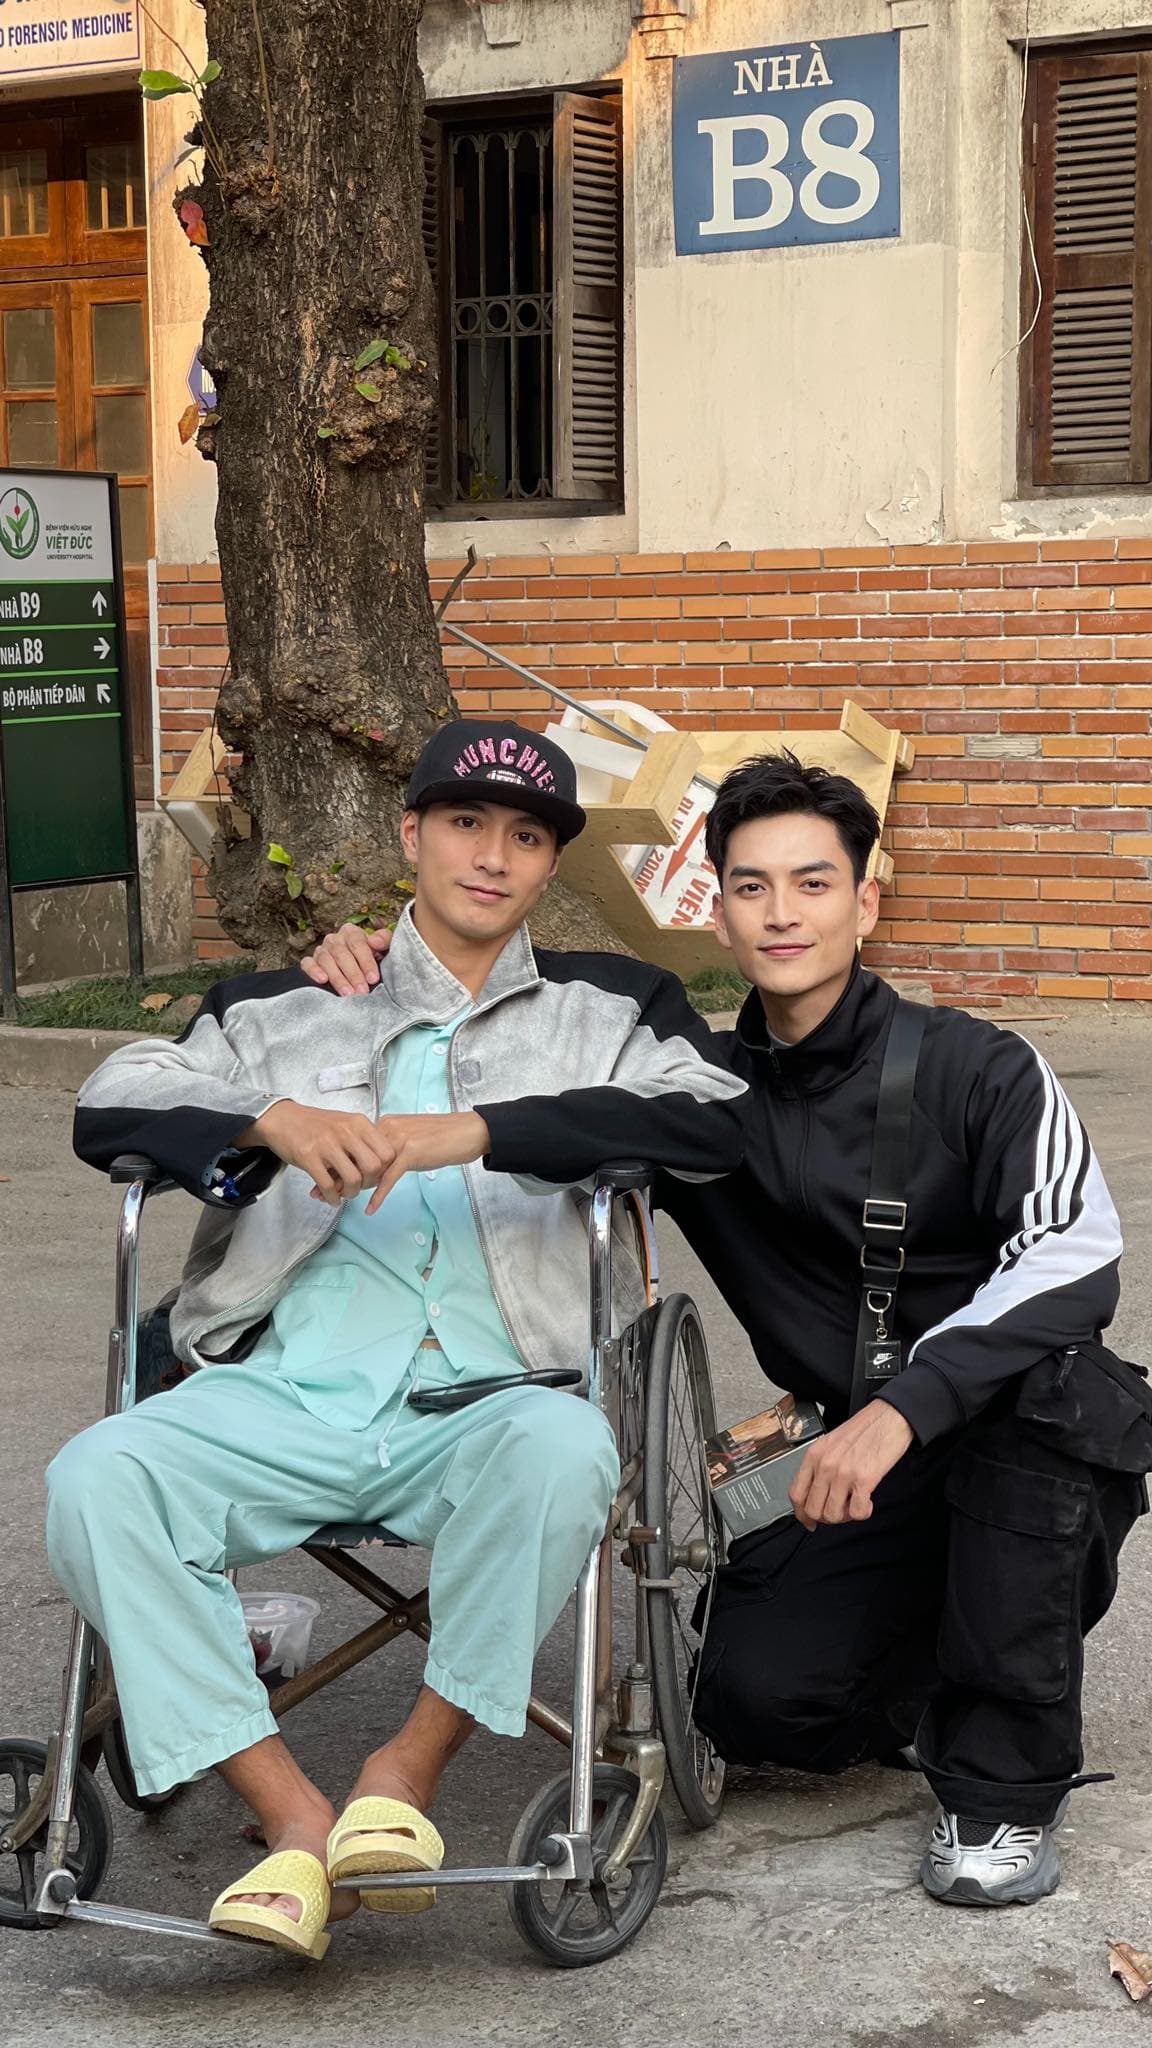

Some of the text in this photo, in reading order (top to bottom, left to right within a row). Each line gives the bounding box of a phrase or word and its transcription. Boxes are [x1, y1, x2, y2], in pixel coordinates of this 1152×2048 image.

[8, 20, 68, 46] FORENSIC
[72, 12, 133, 39] MEDICINE
[733, 42, 833, 95] NHÀ
[697, 99, 880, 235] B8
[46, 532, 93, 553] VIỆT ĐỨC
[20, 592, 40, 618] B9
[0, 638, 44, 665] NHÀ B8
[2, 683, 86, 711] BỘ PHẬN TIẾP DÂN
[670, 878, 711, 926] VIỆN
